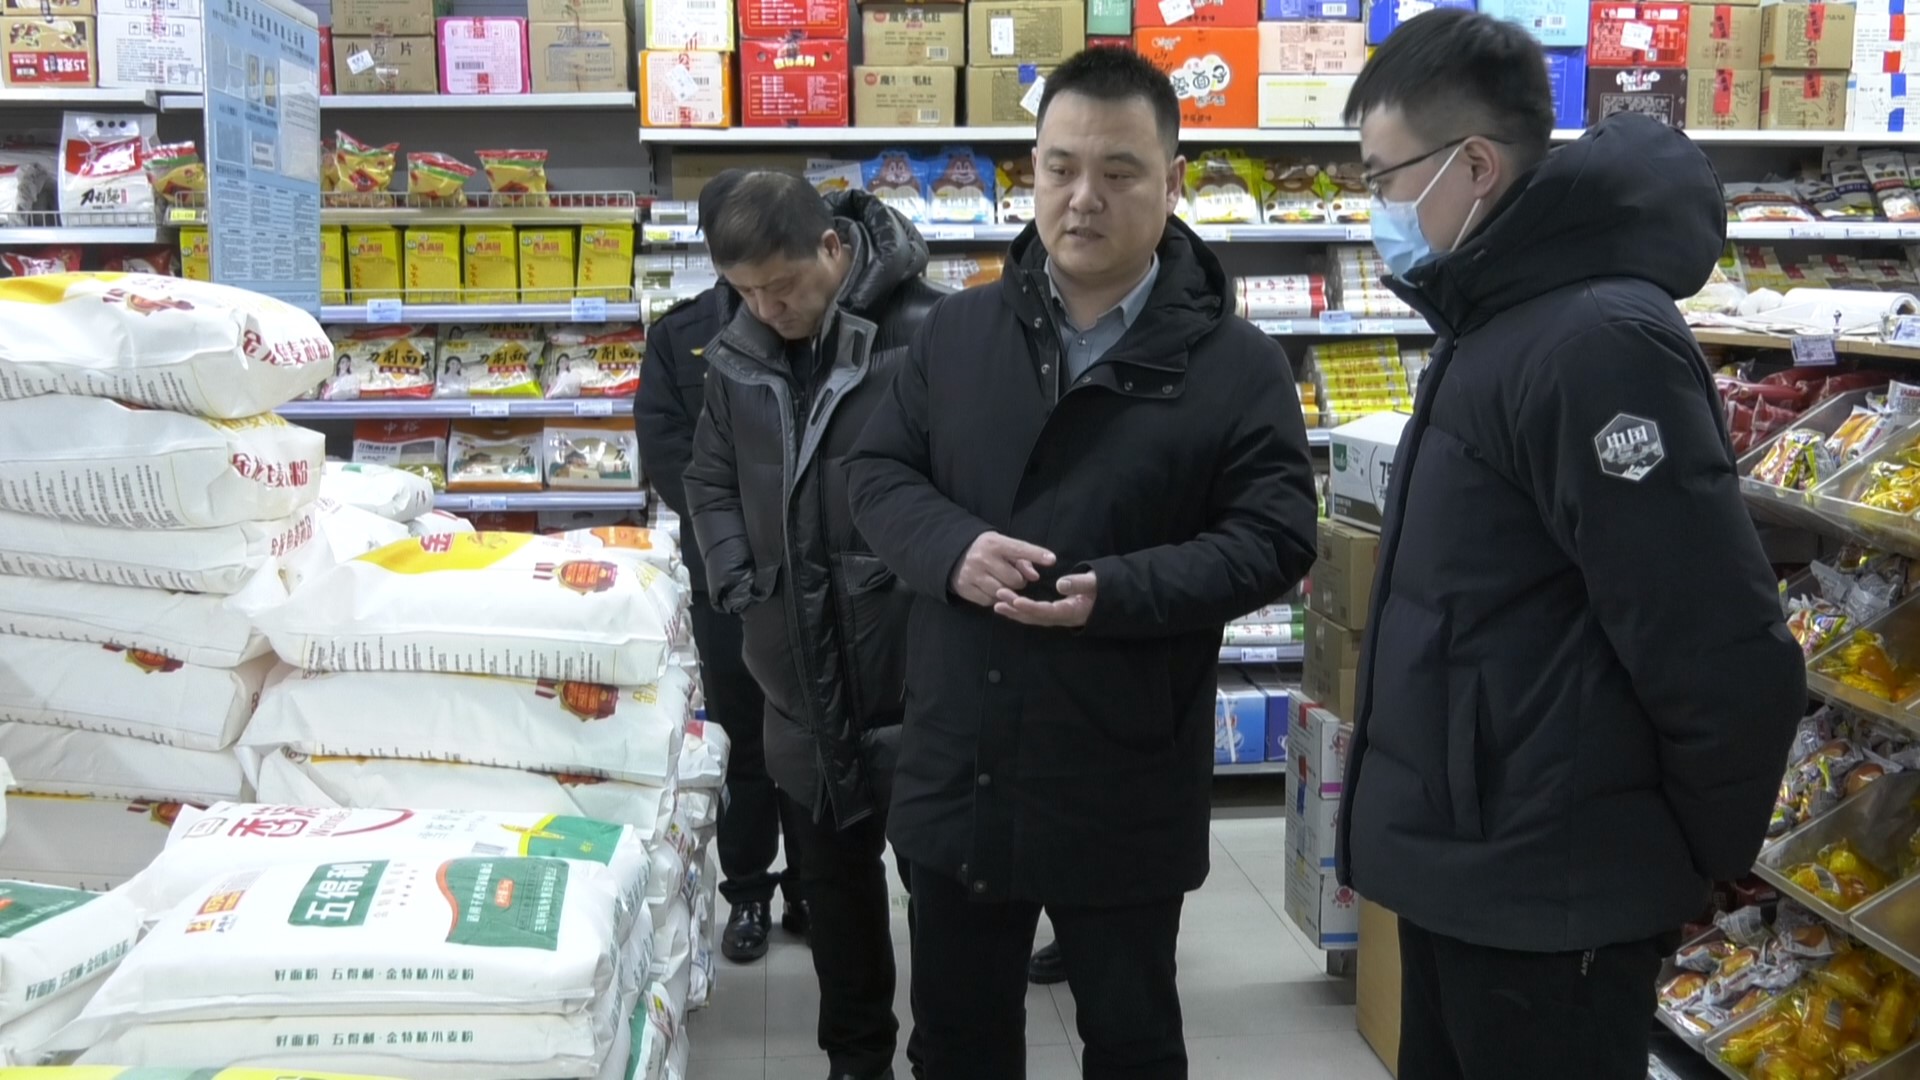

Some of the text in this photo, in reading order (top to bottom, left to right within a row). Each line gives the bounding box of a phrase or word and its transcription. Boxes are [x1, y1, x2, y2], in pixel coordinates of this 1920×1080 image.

[1606, 425, 1648, 449] 中国
[274, 967, 474, 982] 好面粉 五得利·金特精小麦粉
[276, 1031, 474, 1048] 好面粉 五得利·金特精小麦粉
